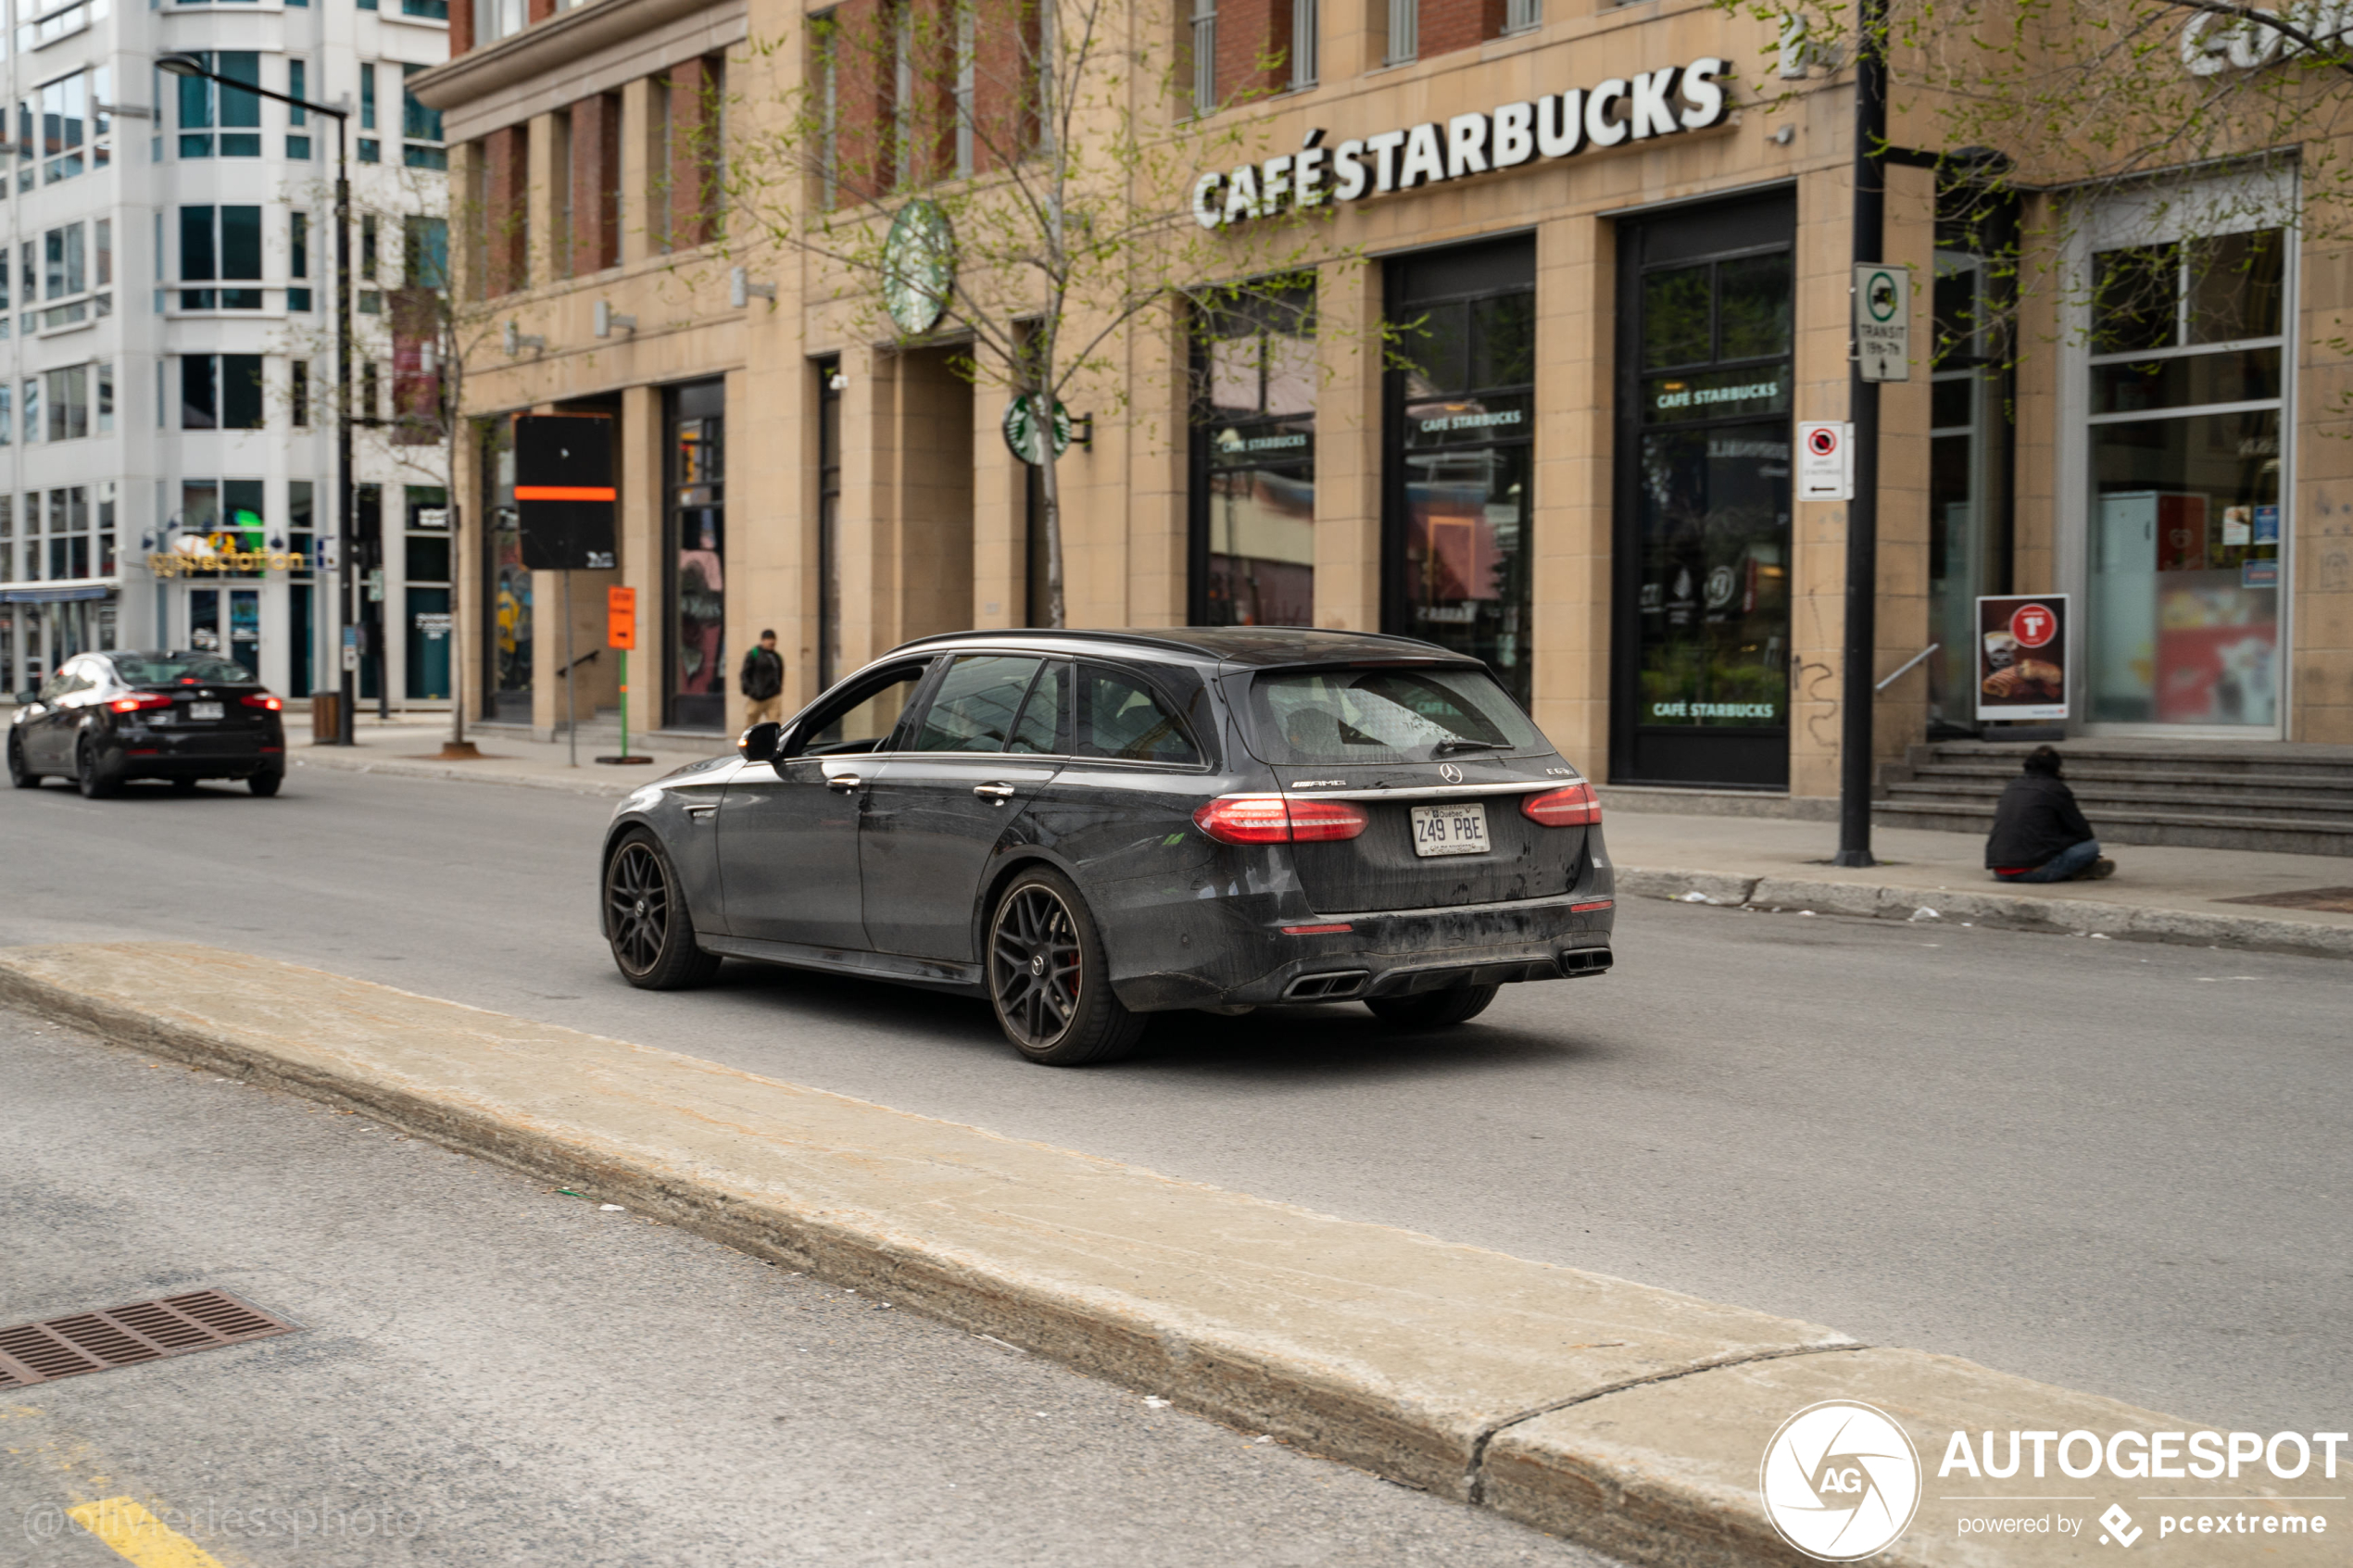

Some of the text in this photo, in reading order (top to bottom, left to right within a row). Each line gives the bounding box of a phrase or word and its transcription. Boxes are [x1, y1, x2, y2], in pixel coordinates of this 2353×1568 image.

[1193, 56, 1730, 230] CAFÉ STARBUCKS
[1860, 323, 1905, 339] TRANSIT
[1656, 382, 1778, 409] CAFÉ STARBUCKS
[1452, 409, 1521, 430] STARBUCKS
[1248, 433, 1306, 451] STARBUCKS
[1653, 699, 1774, 718] CAFÉ STARBUCKS
[1416, 817, 1483, 843] Z49 PBE
